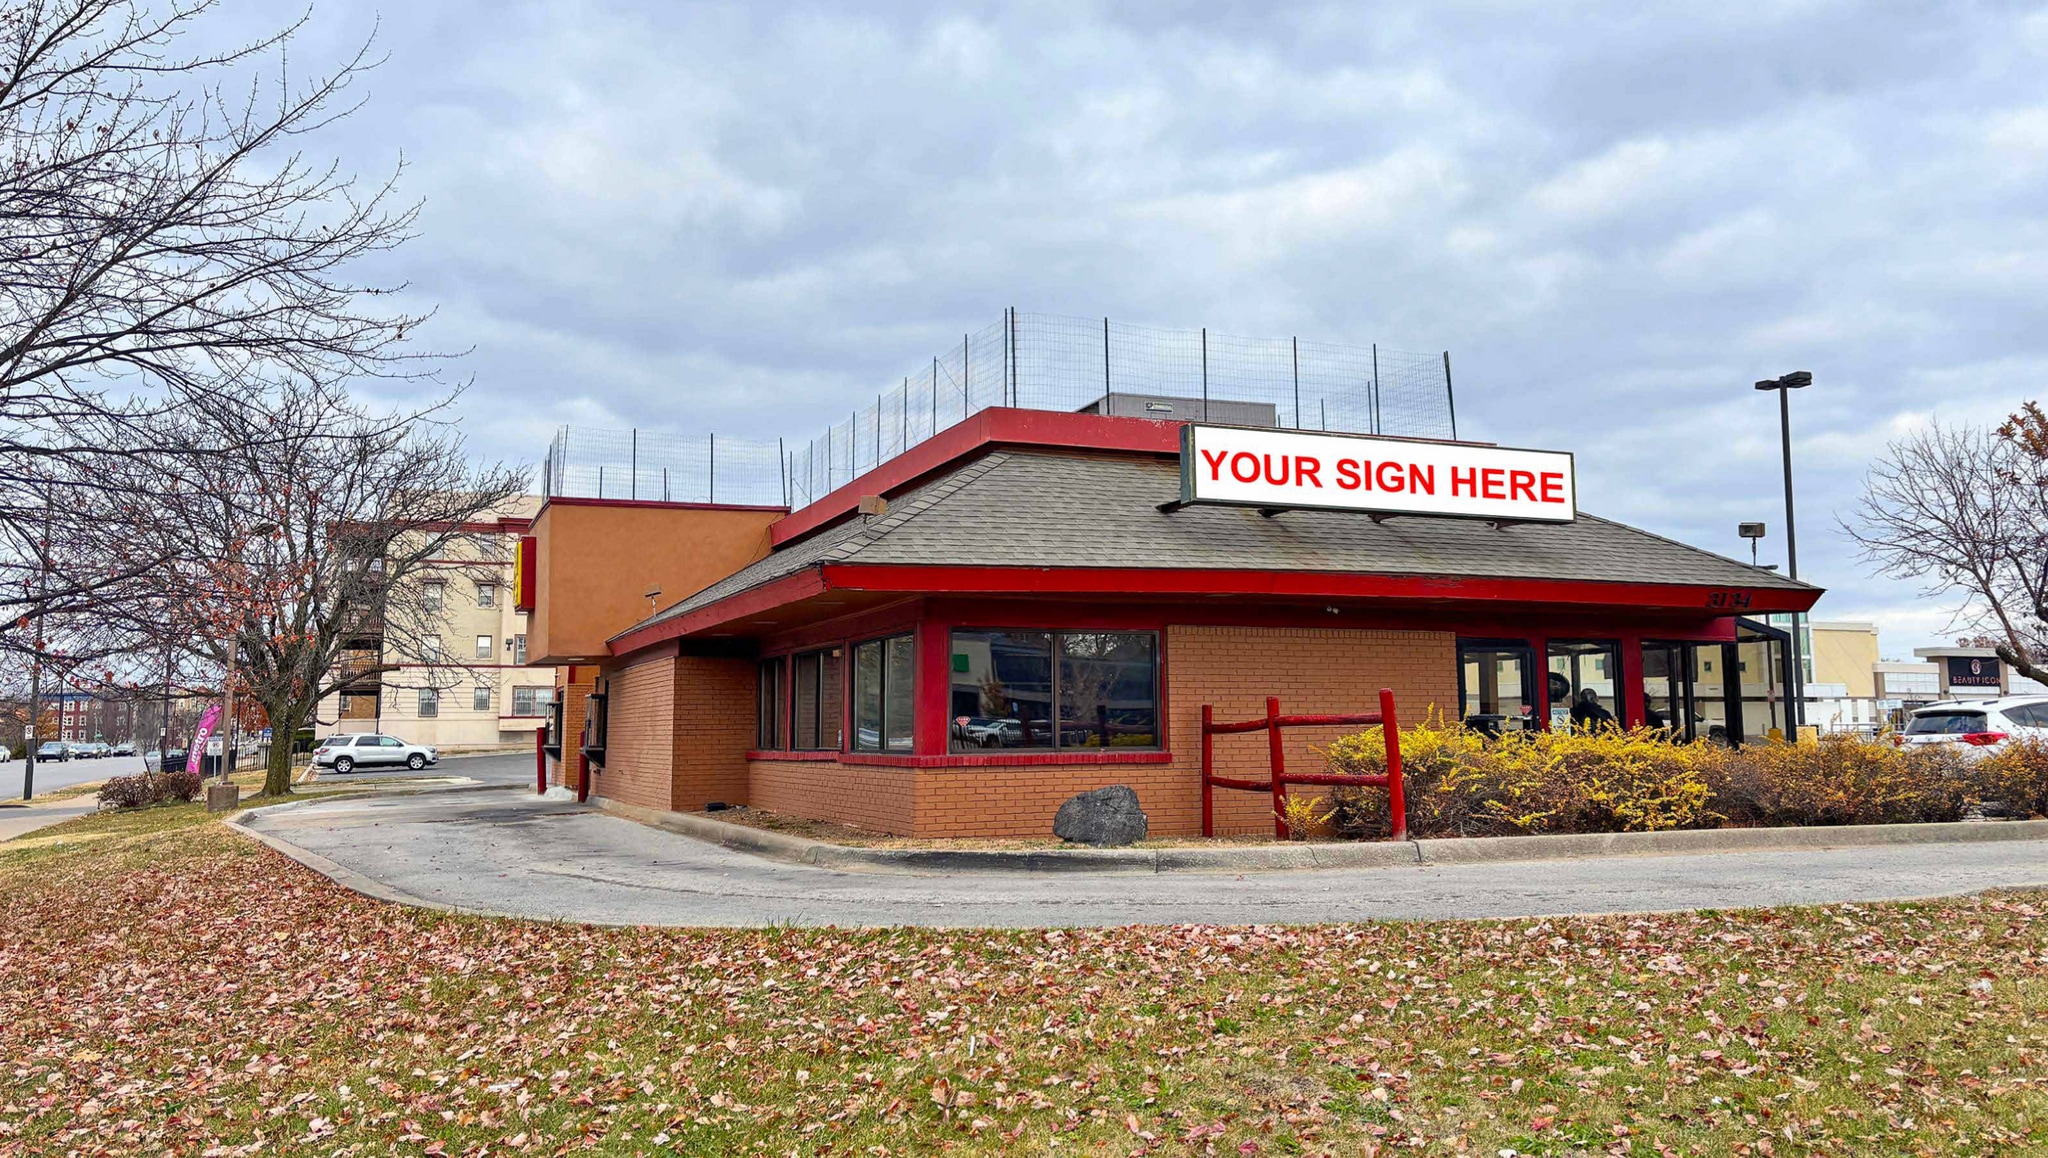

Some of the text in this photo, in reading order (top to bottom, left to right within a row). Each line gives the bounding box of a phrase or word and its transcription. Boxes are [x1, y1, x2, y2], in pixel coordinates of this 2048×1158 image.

[1200, 449, 1565, 503] YOUR SIGN HERE
[1707, 592, 1752, 608] 3134
[1953, 676, 2001, 684] BEAUTY ICON
[191, 727, 208, 765] metro
